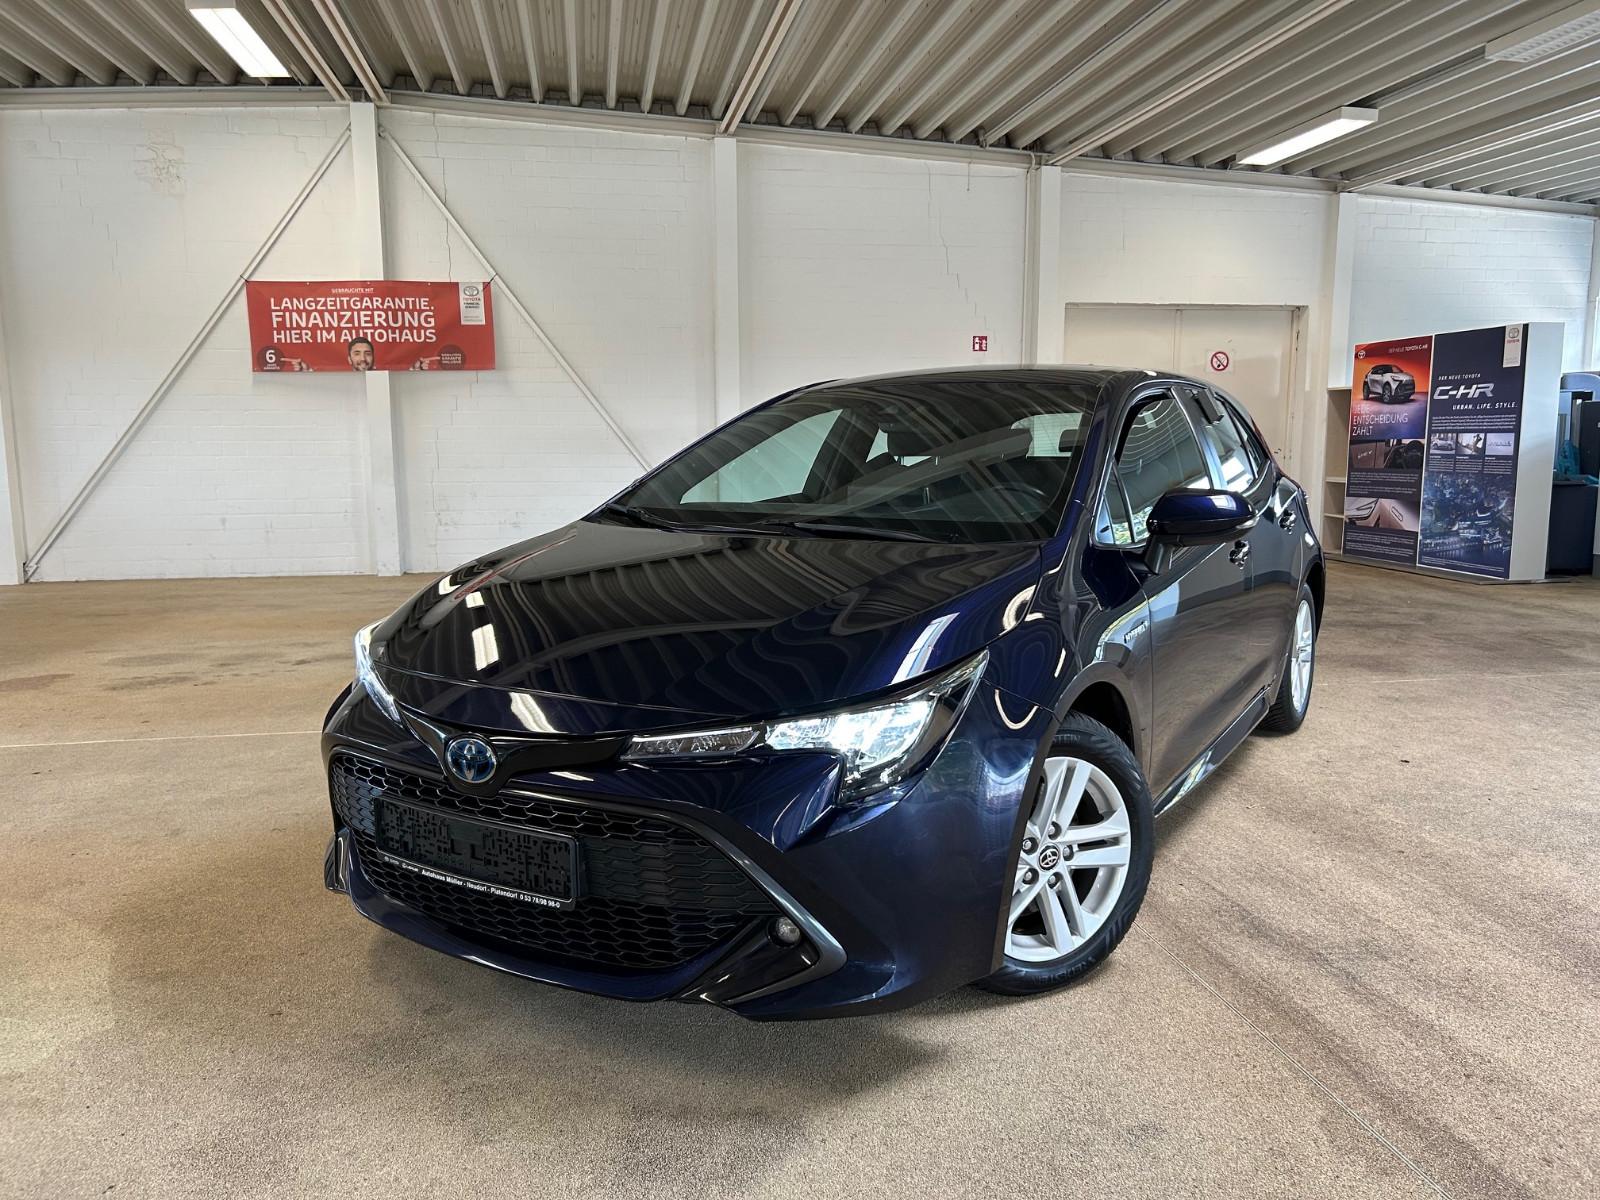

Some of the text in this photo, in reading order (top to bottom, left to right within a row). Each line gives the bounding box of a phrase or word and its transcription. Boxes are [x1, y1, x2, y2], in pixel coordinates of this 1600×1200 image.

[270, 297, 434, 310] LANGZEITGARANTIE.
[271, 311, 435, 328] FINANZIERUNG
[273, 329, 437, 343] HIER IM AUTOHAUS
[265, 349, 276, 363] 6
[1433, 383, 1495, 400] C-HR
[1353, 413, 1409, 425] ENTSCHEIDUNG
[421, 869, 445, 880] Autohaus
